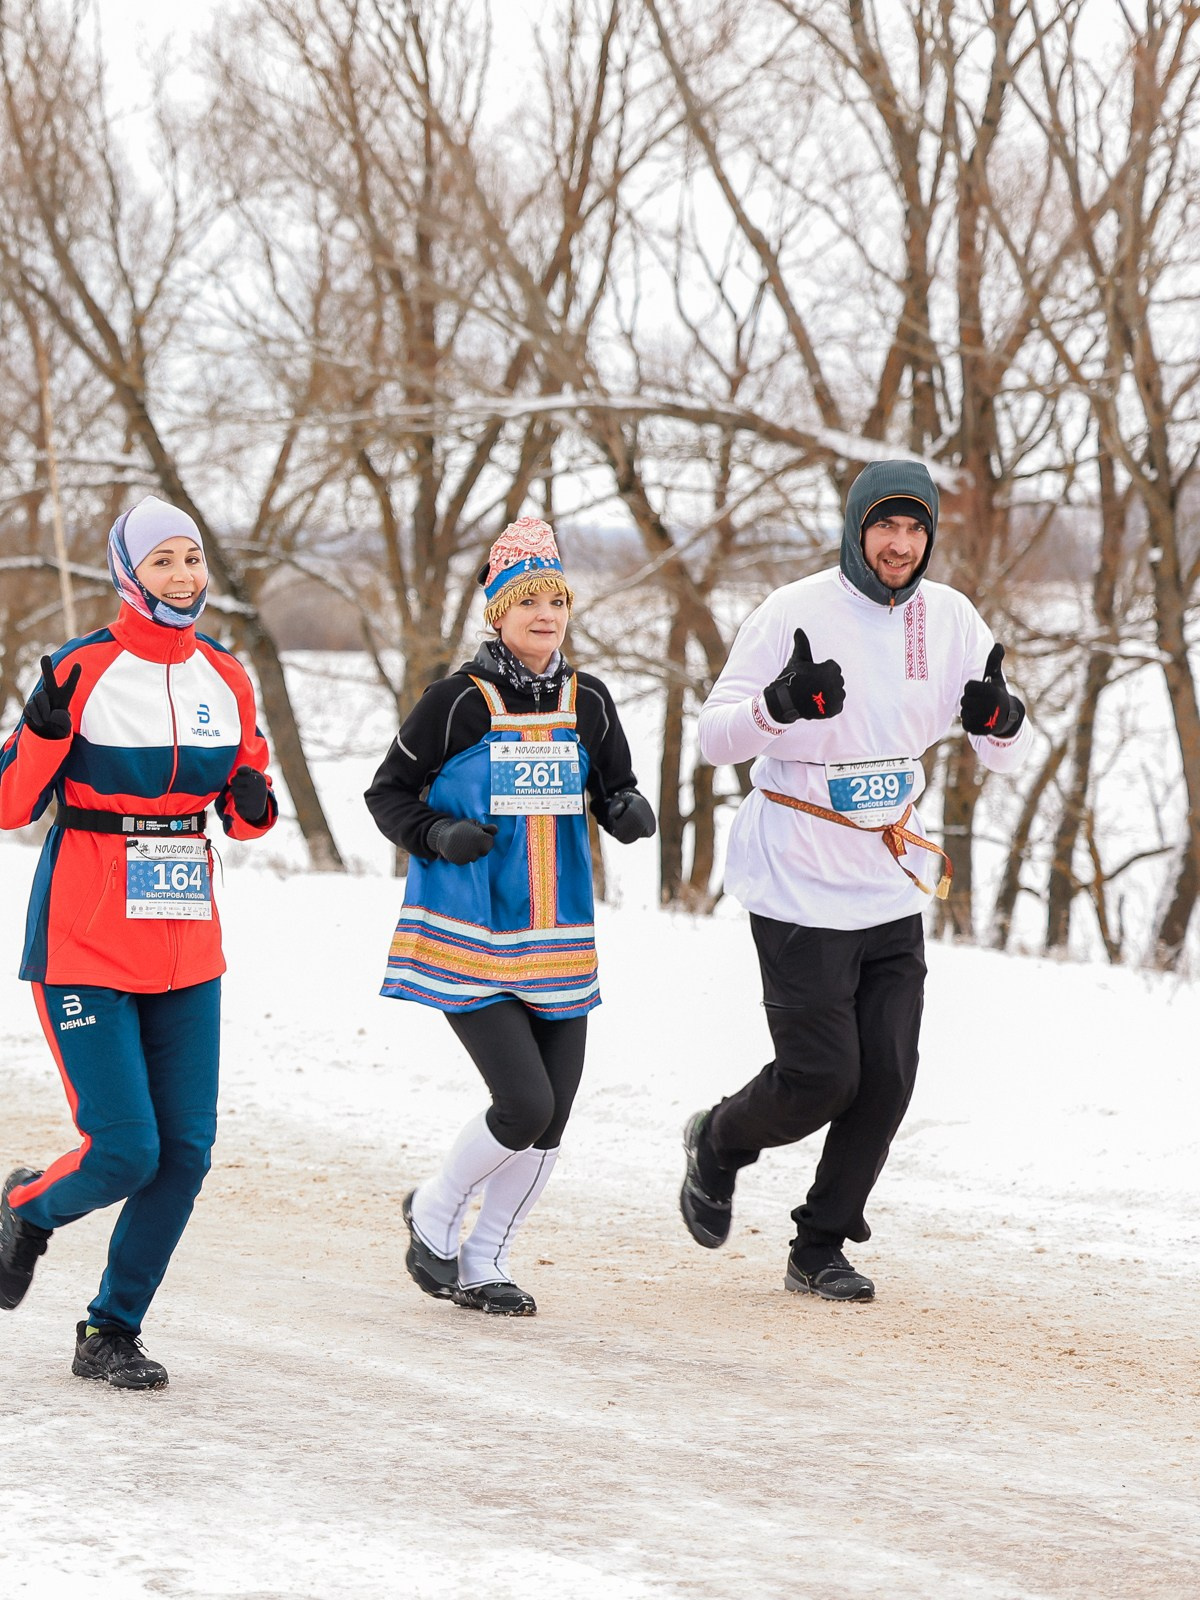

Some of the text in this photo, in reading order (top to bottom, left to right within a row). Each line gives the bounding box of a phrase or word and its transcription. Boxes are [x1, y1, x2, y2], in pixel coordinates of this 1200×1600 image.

[514, 762, 563, 787] 261
[850, 774, 899, 802] 289
[154, 844, 194, 854] NOVGOROD
[153, 863, 202, 891] 164
[146, 891, 184, 899] БЫСТРОВА
